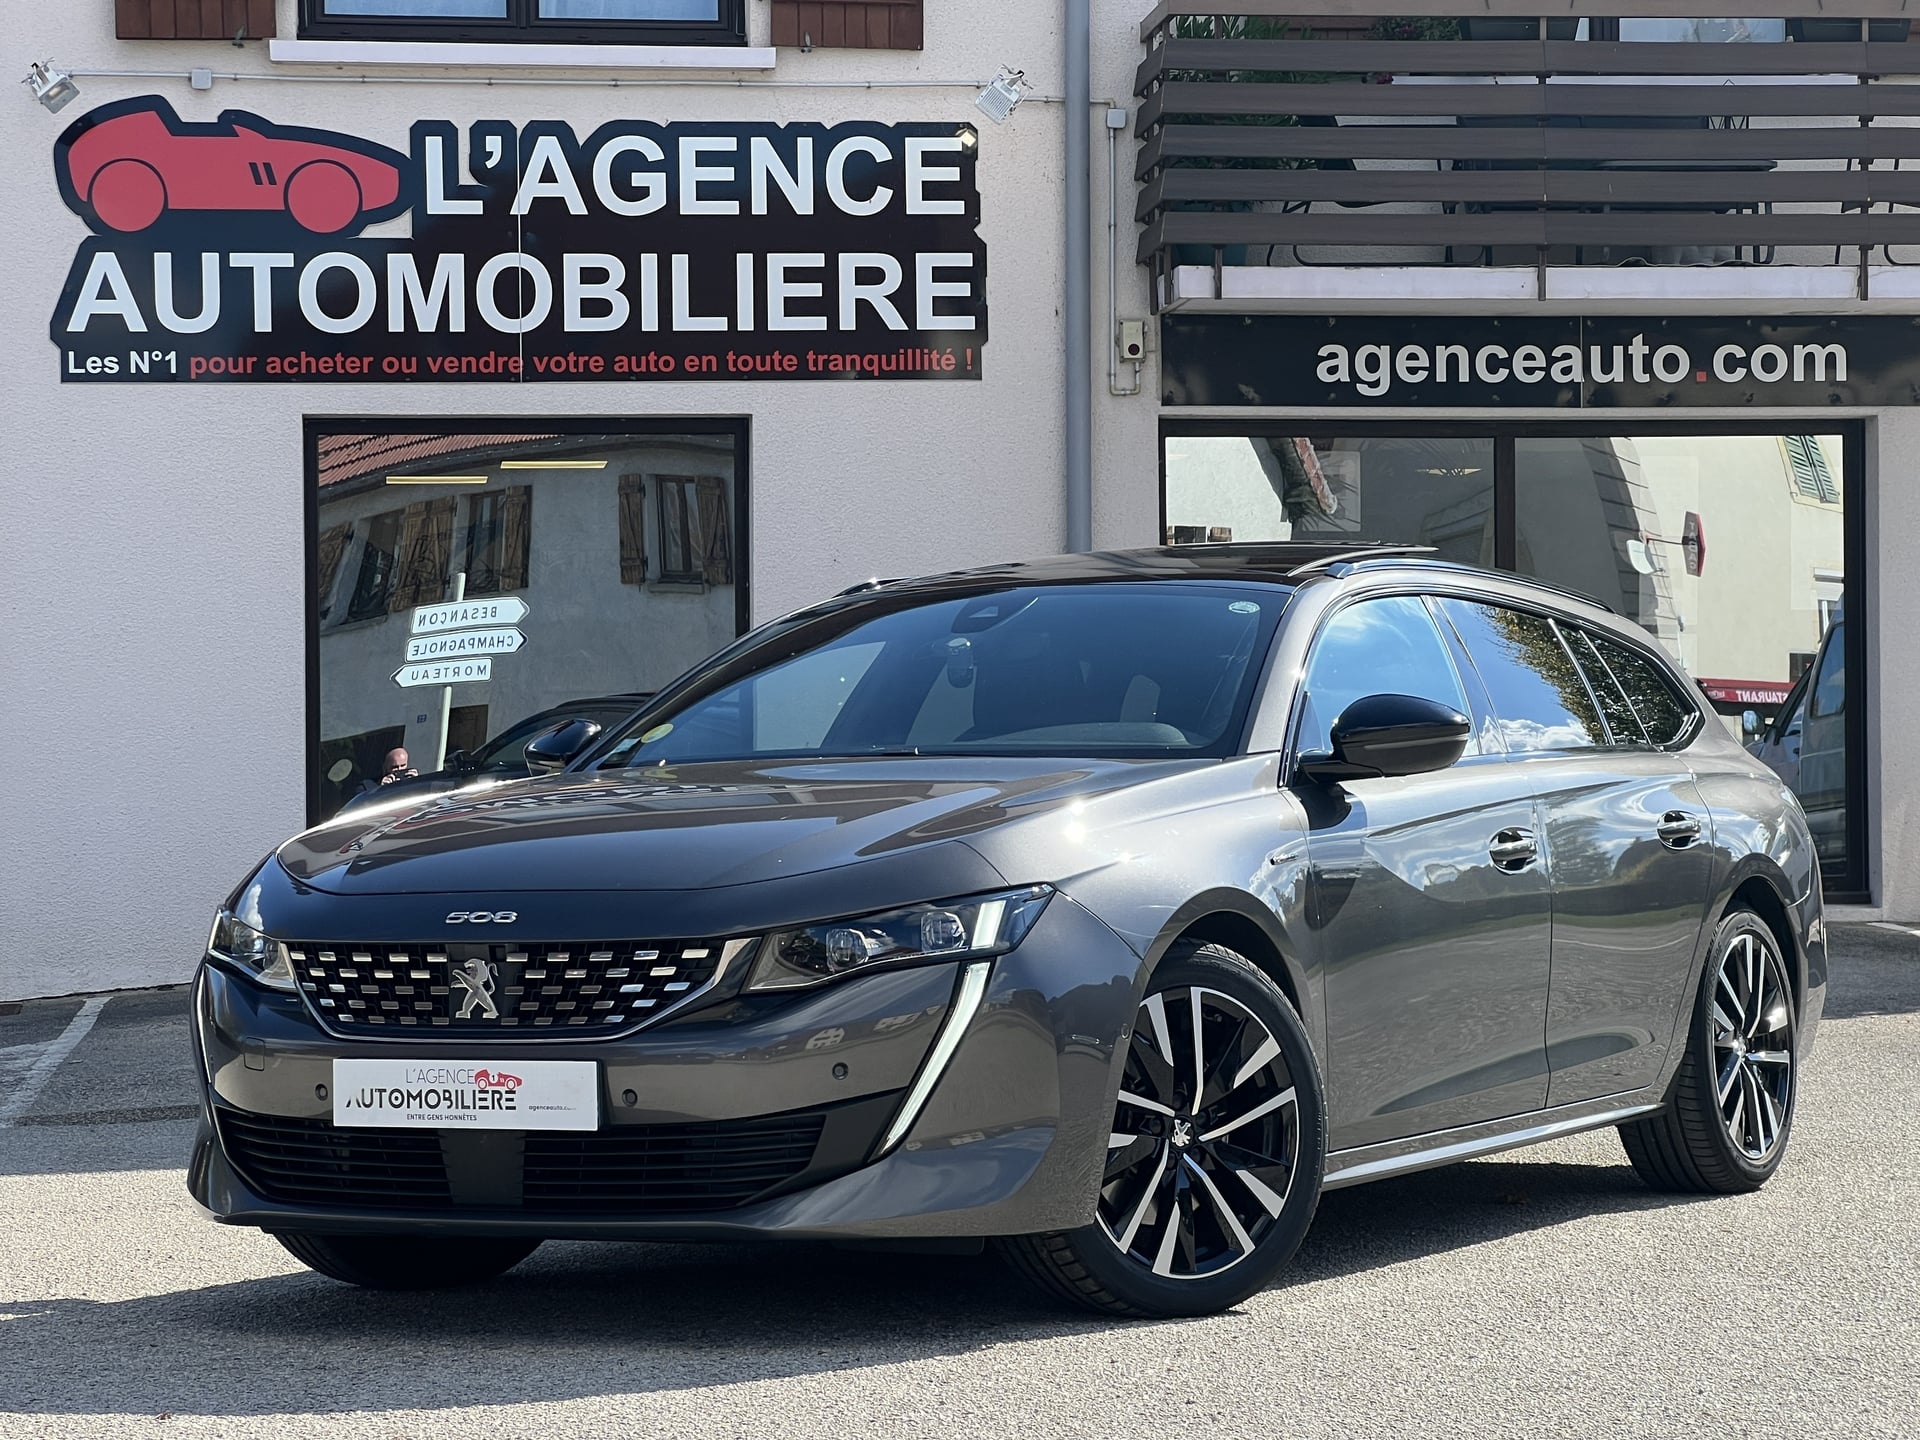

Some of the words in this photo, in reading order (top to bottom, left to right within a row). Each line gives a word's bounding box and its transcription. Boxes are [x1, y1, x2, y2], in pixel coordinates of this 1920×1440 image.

[425, 135, 966, 217] L'AGENCE
[66, 251, 976, 334] AUTOMOBILIERE
[68, 351, 120, 375] Les
[131, 351, 178, 375] N°1
[191, 357, 257, 379] pour
[267, 352, 373, 374] acheter
[383, 357, 418, 374] ou
[427, 351, 522, 374] vendre
[534, 354, 605, 373] votre
[614, 353, 676, 373] auto
[684, 356, 718, 373] en
[727, 351, 798, 373] toute
[807, 349, 956, 377] tranquillité
[966, 350, 974, 372] !
[1316, 333, 1848, 397] agenceauto.com
[445, 911, 518, 924] 508
[405, 1068, 475, 1085] L'AGENCE
[406, 1113, 426, 1121] ENTRE
[427, 1113, 444, 1121] GENS
[445, 1112, 477, 1121] HONNÊTES
